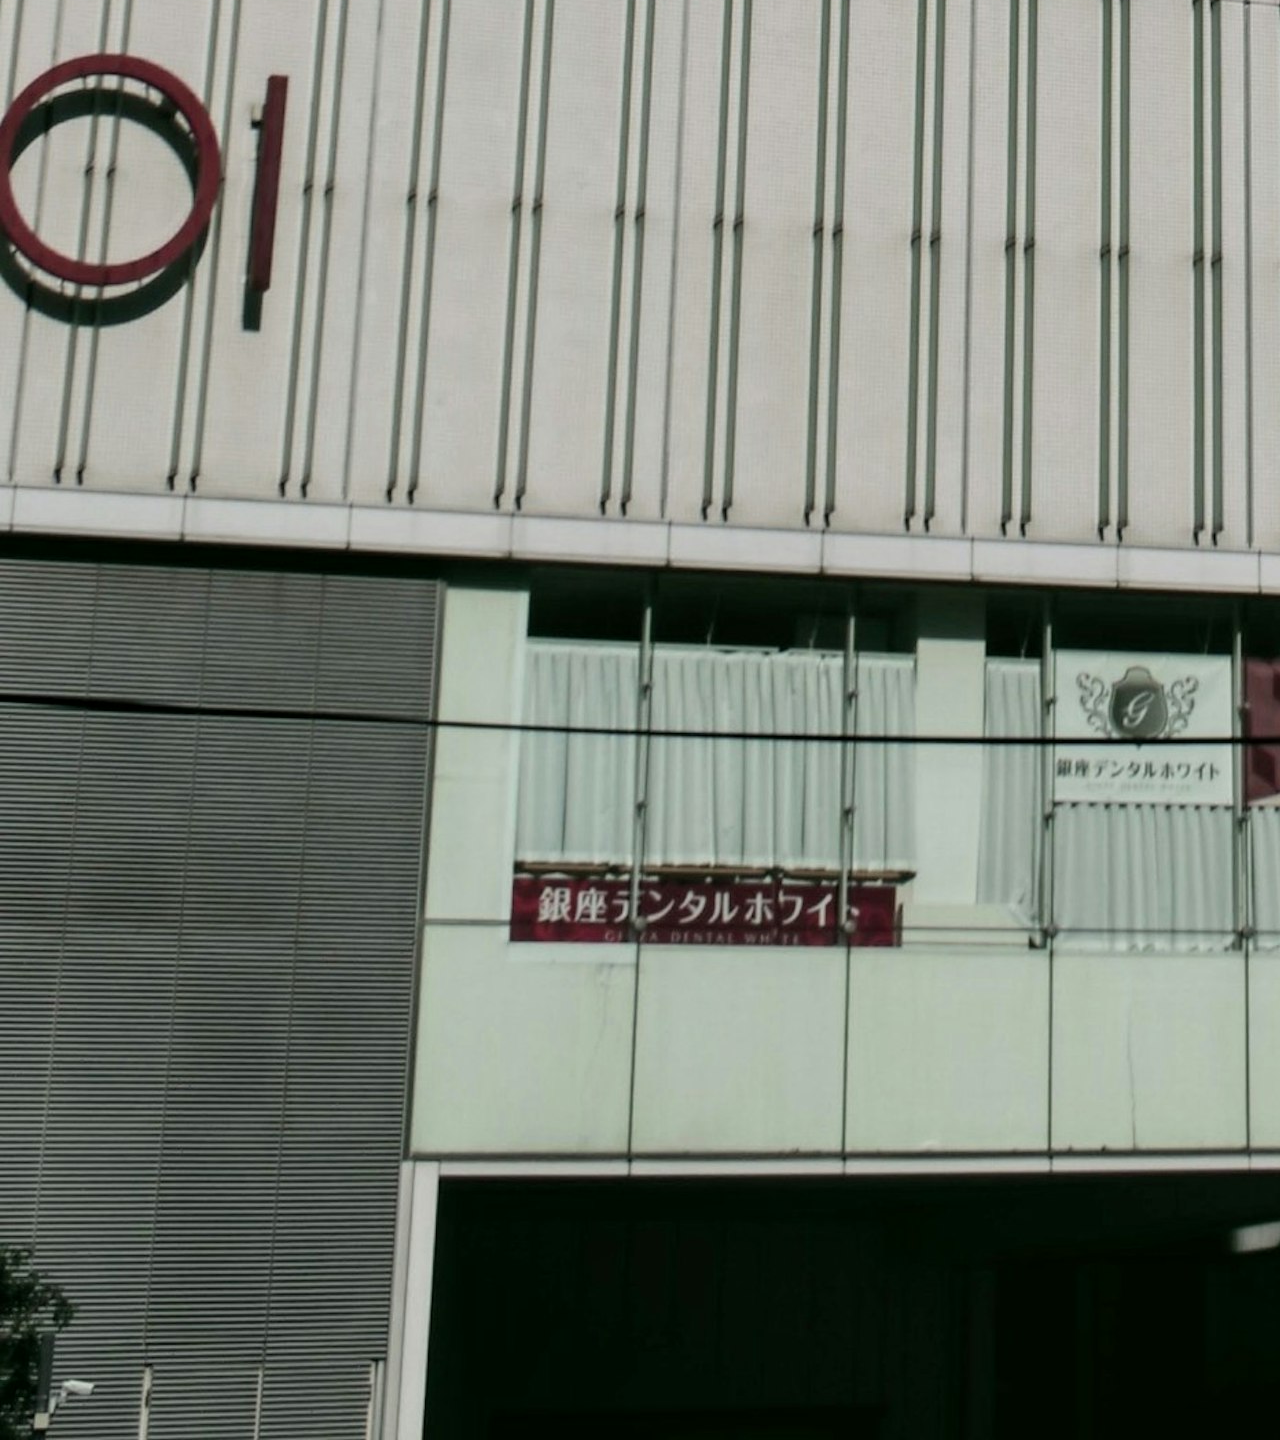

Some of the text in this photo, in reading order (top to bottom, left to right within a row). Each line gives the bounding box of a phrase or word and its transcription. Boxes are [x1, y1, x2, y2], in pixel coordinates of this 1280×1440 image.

[1056, 757, 1220, 782] 銀座デンタルホワイト
[604, 930, 659, 943] GIZA
